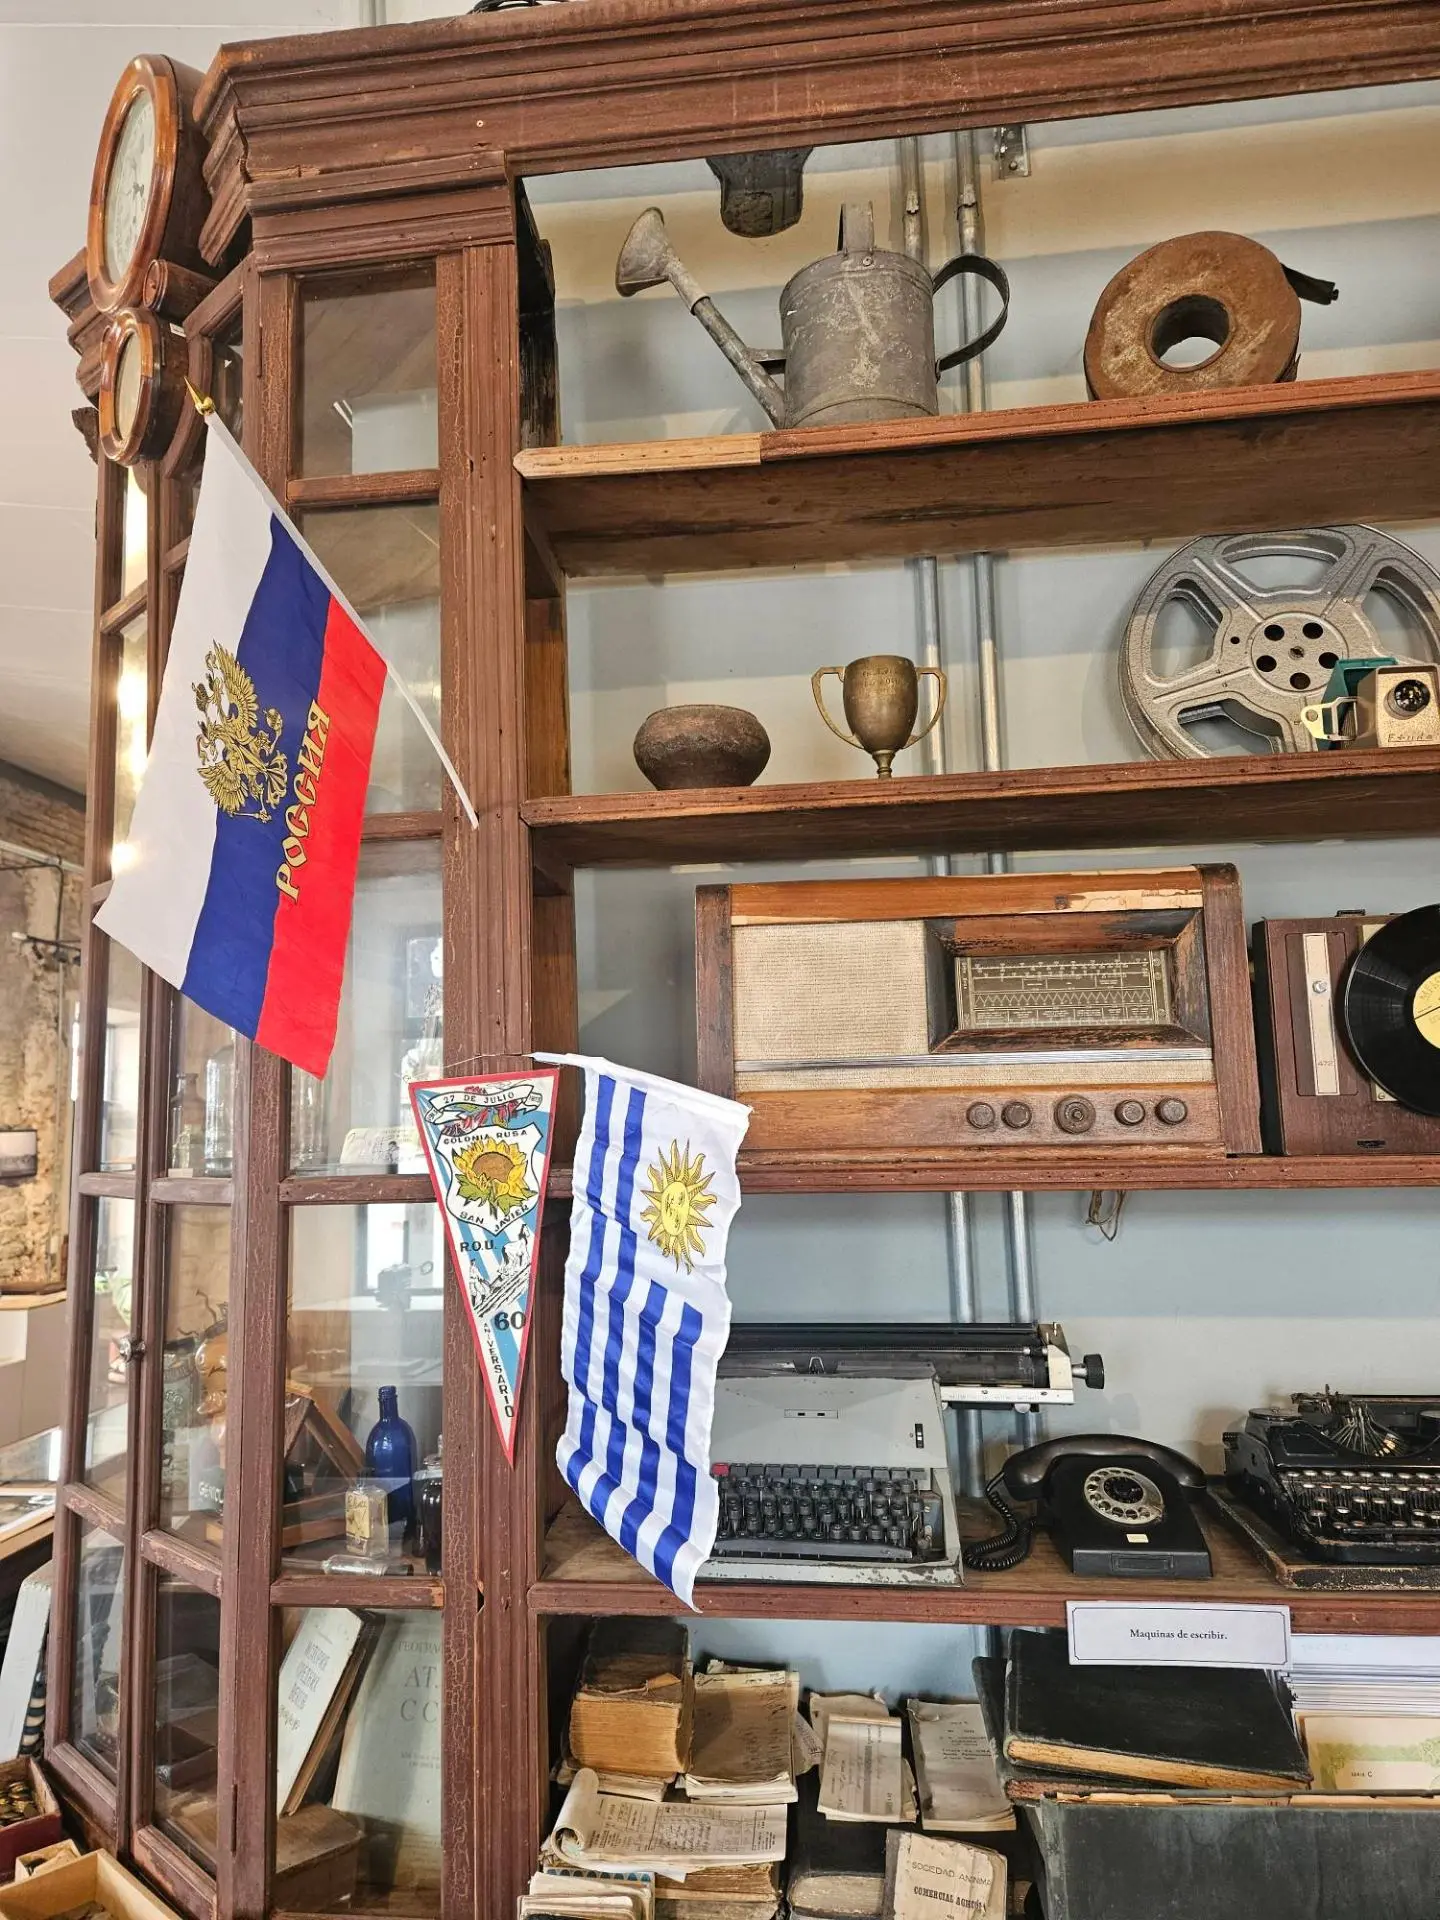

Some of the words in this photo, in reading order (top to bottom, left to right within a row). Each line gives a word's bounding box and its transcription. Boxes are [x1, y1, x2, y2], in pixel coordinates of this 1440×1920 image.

[275, 699, 331, 905] РОССИЯ
[443, 1095, 455, 1104] 27
[463, 1093, 476, 1102] DE
[483, 1092, 515, 1104] JULIO
[443, 1133, 490, 1145] COLONIA
[496, 1130, 528, 1138] RUSA
[459, 1211, 485, 1225] SAN
[494, 1205, 530, 1232] JAVIER
[494, 1311, 527, 1331] 60
[483, 1322, 515, 1418] ANIVERSARIO
[1130, 1628, 1175, 1640] Maquinas
[1177, 1629, 1188, 1639] de
[1190, 1630, 1228, 1640] escribir.
[913, 1886, 954, 1903] COMERCIAL
